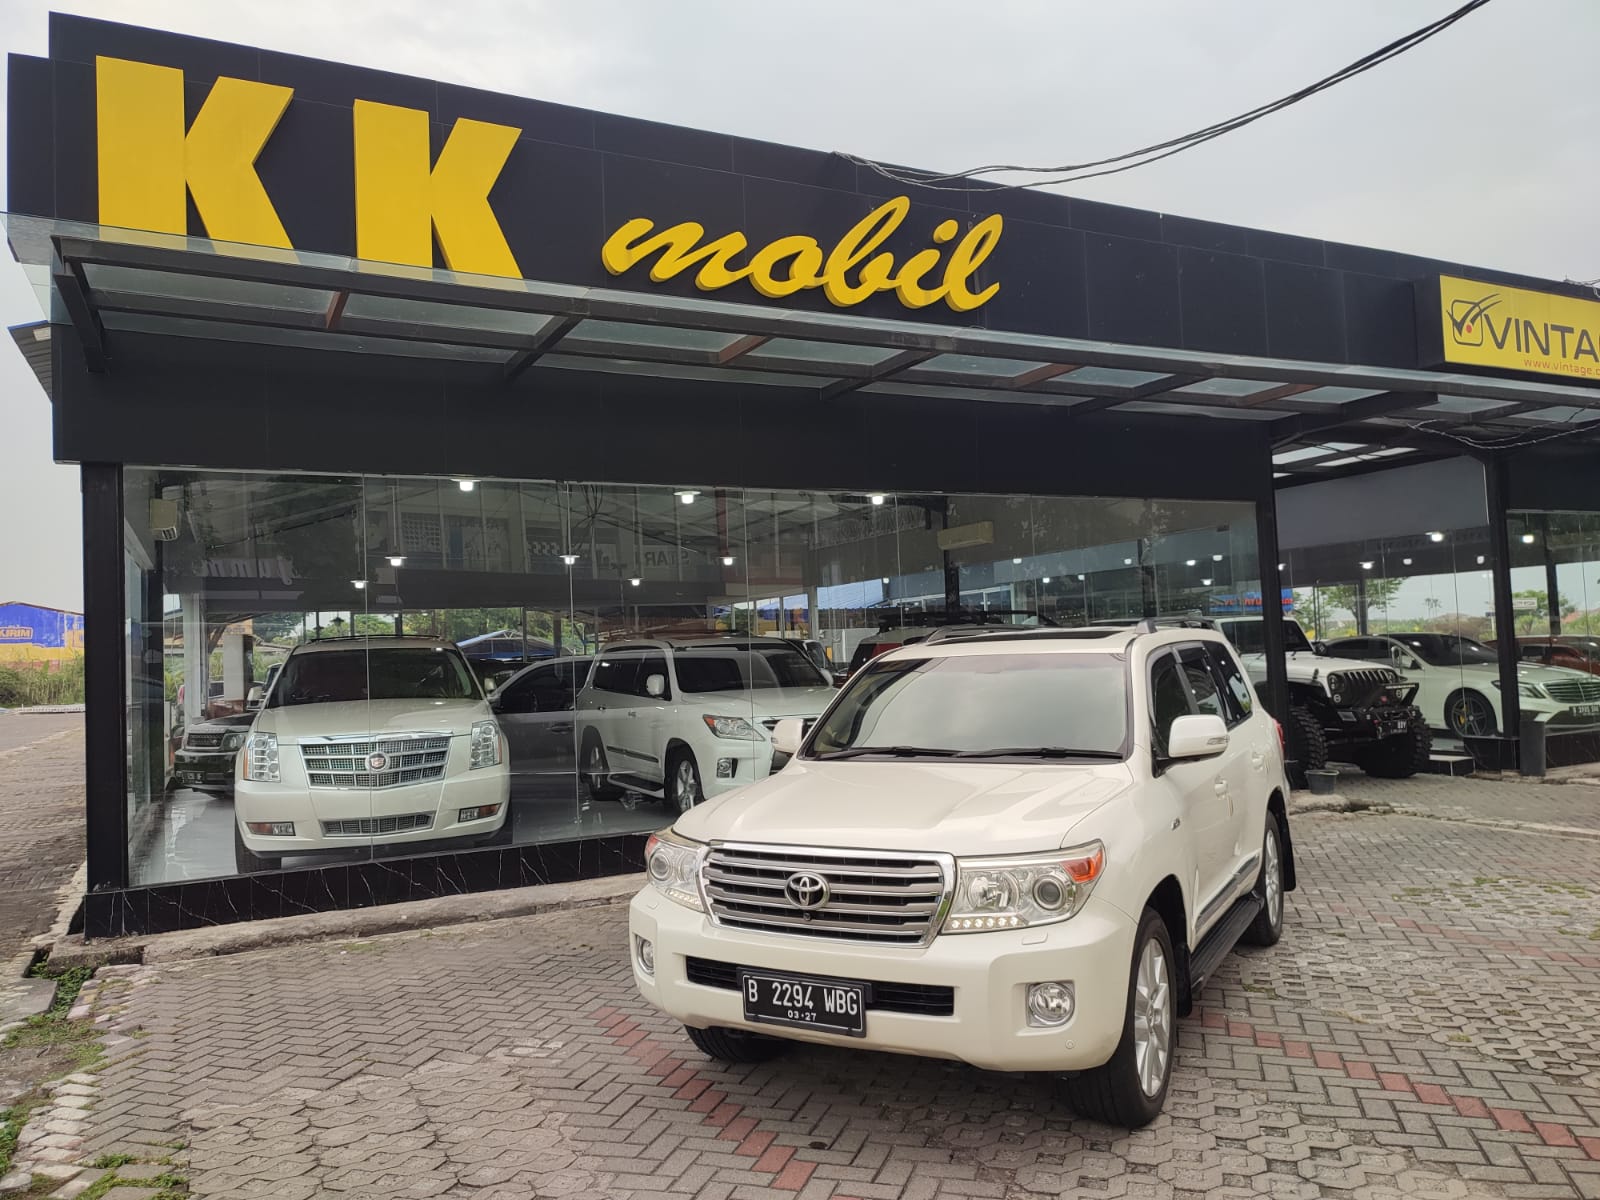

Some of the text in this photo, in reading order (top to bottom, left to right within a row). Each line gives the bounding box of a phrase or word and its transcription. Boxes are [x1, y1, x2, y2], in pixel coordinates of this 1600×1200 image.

[601, 195, 1004, 312] mobil
[1484, 313, 1600, 363] VINTA
[748, 979, 858, 1015] B 2294 WBG
